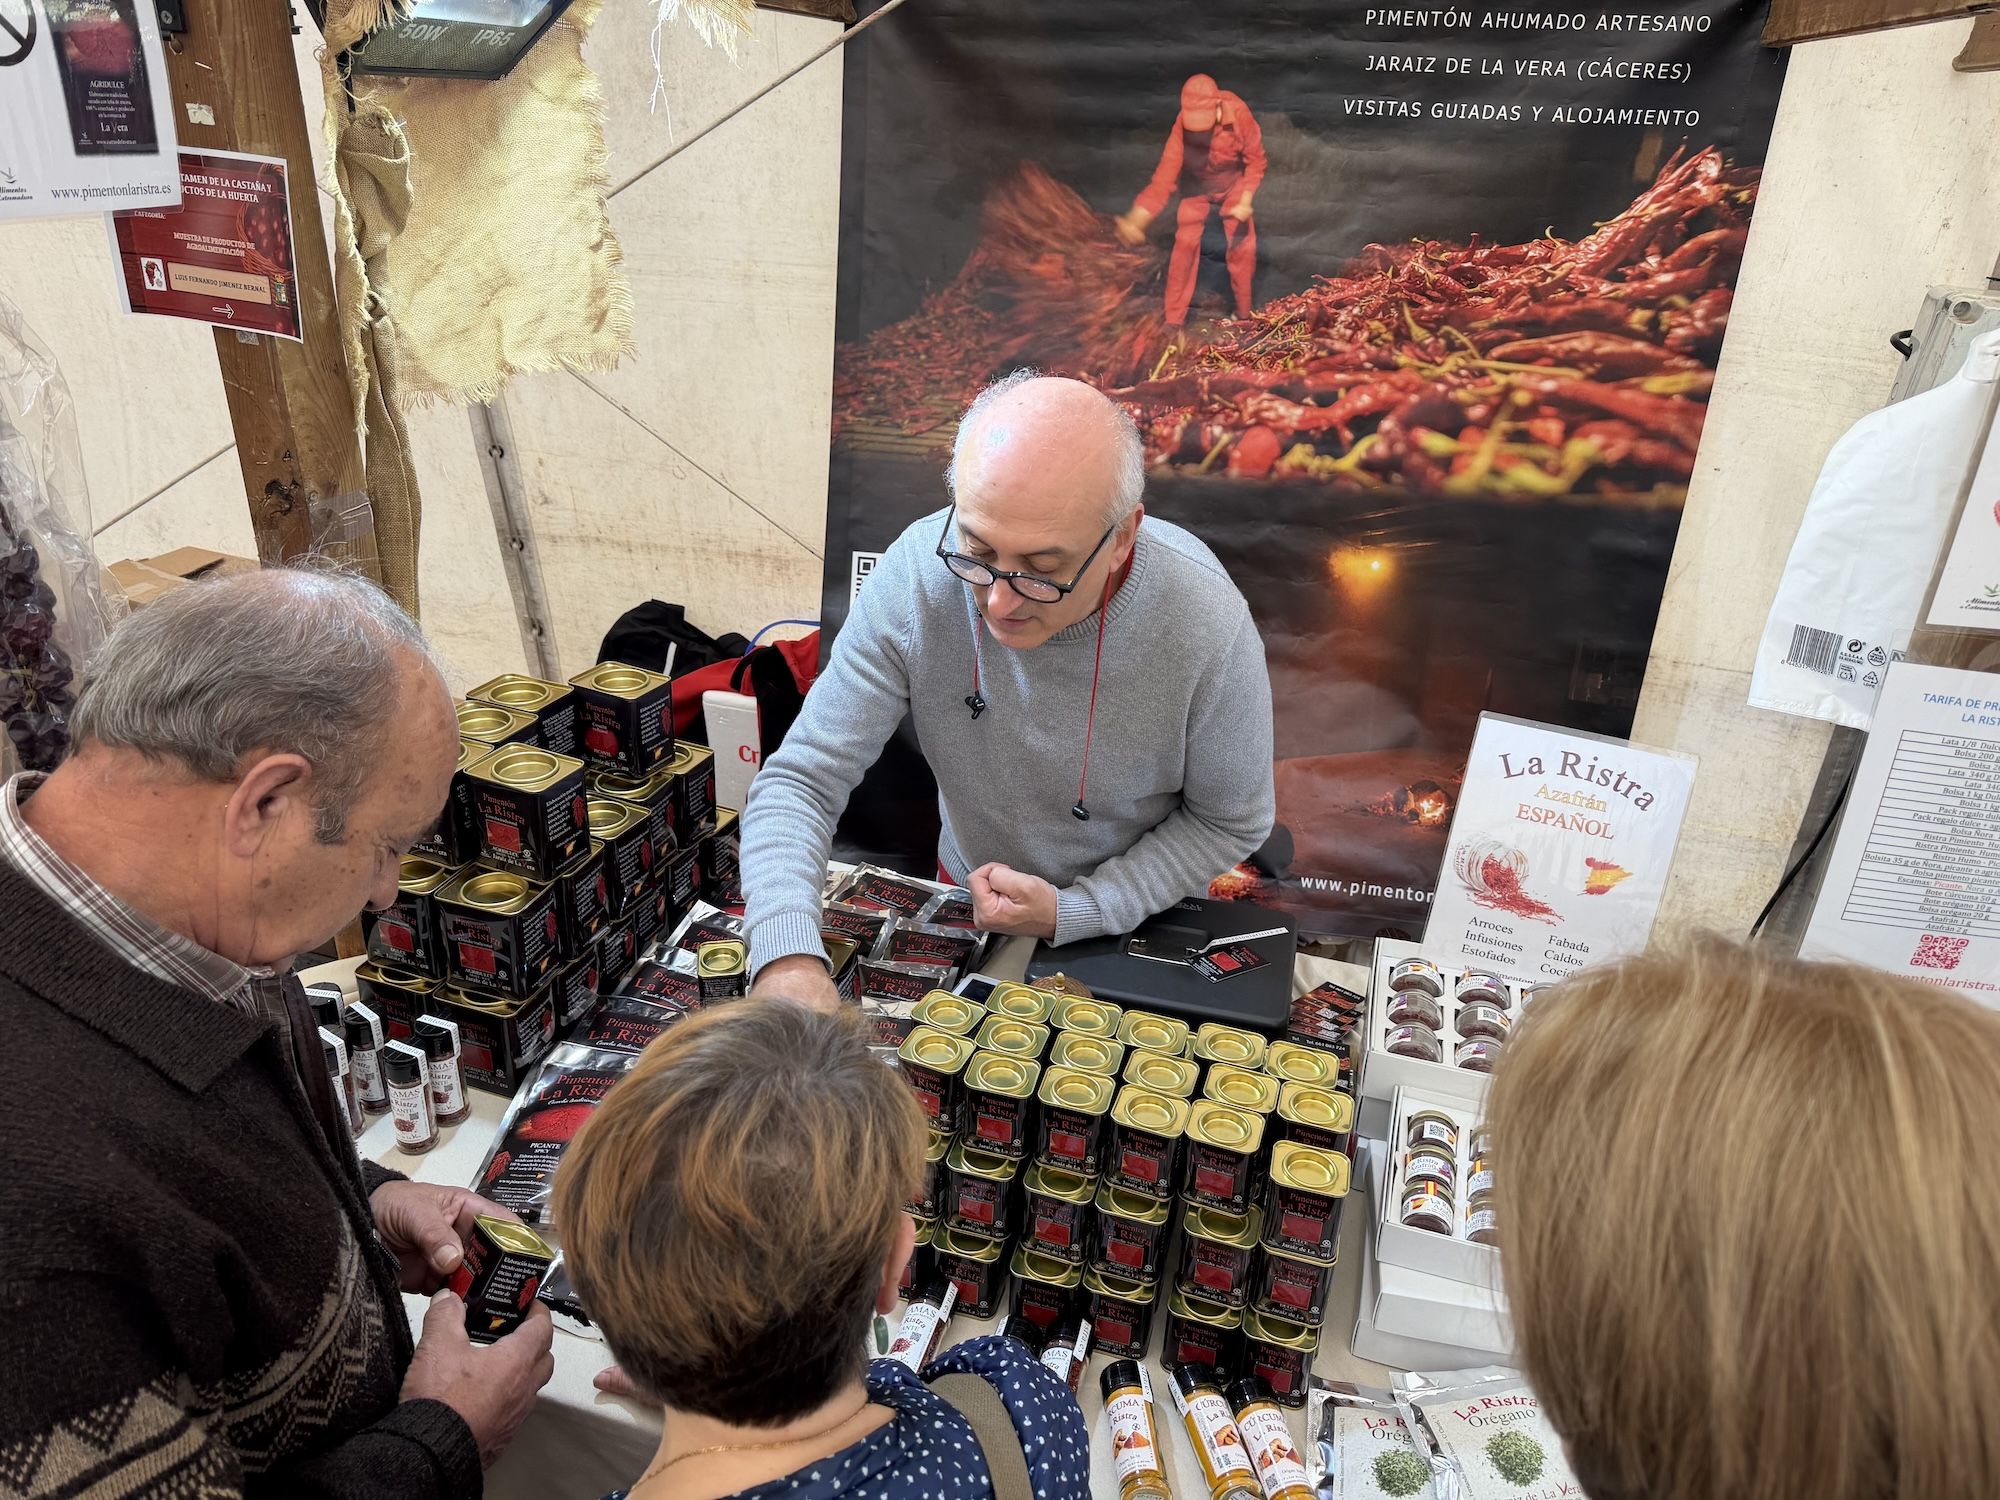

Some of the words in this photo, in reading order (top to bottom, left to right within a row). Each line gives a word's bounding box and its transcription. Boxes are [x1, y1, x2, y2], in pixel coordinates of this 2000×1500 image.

[1365, 6, 1472, 28] PIMENTÓN
[1481, 12, 1586, 30] AHUMADO
[1595, 15, 1711, 32] ARTESANO
[399, 23, 448, 41] 50W
[470, 29, 515, 46] IP65
[1365, 56, 1436, 73] JARAIZ
[1445, 57, 1472, 74] DE
[1481, 59, 1503, 75] LA
[1515, 60, 1566, 77] VERA
[1577, 57, 1692, 83] (CÁCERES)
[1343, 100, 1422, 117] VISITAS
[1432, 102, 1521, 120] GUIADAS
[1532, 106, 1543, 121] Y
[1552, 107, 1700, 127] ALOJAMIENTO
[51, 183, 172, 201] www.pimentonlaristra.es
[209, 176, 219, 186] DE
[220, 178, 231, 188] LA
[231, 178, 266, 192] CASTAÑA
[267, 183, 272, 192] Y
[206, 187, 216, 197] DE
[217, 190, 226, 199] LA
[229, 190, 259, 203] HUERTA
[1923, 693, 1962, 706] TARIFA
[1965, 699, 1981, 709] DE
[1961, 713, 1975, 722] LA
[1941, 737, 1959, 745] Lata
[1961, 739, 1977, 748] 1/8
[1954, 749, 1976, 758] Bolsa
[1978, 751, 1994, 760] 200
[1948, 768, 1965, 776] Lata
[1969, 770, 1985, 779] 340
[1968, 761, 1990, 770] Bolsa
[1499, 752, 1545, 779] La
[1556, 751, 1655, 811] Ristra
[1965, 780, 1982, 788] Lata
[1534, 782, 1607, 812] Azafrán
[1943, 787, 1964, 796] Bolsa
[1939, 806, 1958, 815] Pack
[1960, 799, 1981, 808] Bolsa
[1515, 803, 1615, 840] ESPAÑOL
[1913, 813, 1931, 821] Pack
[1924, 833, 1947, 842] Ristra
[1949, 836, 1985, 846] Pimiento
[1951, 827, 1972, 836] Bolsa
[1915, 841, 1939, 850] Ristra
[1940, 844, 1976, 854] Pimiento
[1865, 853, 1891, 863] Bolsita
[1911, 858, 1920, 866] de
[1944, 863, 1973, 873] picante
[1932, 853, 1956, 862] Ristra
[1958, 855, 1981, 864] Humo
[1913, 869, 1933, 877] Bolsa
[1935, 872, 1970, 882] pimiento
[880, 888, 918, 910] Ristra
[1923, 896, 1941, 905] Bote
[1925, 888, 1942, 897] Bote
[1918, 904, 1939, 914] Bolsa
[1468, 915, 1514, 935] Arroces
[1925, 923, 1955, 932] Azafrán
[1928, 915, 1958, 924] Azafrán
[832, 920, 874, 938] Ristra
[896, 940, 915, 950] La
[921, 943, 965, 957] Ristra
[1464, 929, 1524, 953] Infusiones
[1548, 934, 1590, 953] Fabada
[1461, 944, 1517, 966] Estofados
[1544, 950, 1584, 967] Caldos
[870, 971, 924, 989] Pimentón
[635, 977, 656, 991] La
[661, 986, 702, 1010] Ristra
[606, 1018, 662, 1034] Pimentón
[589, 1030, 610, 1040] La
[557, 1074, 616, 1086] Pimentón
[540, 1087, 562, 1100] La
[971, 1103, 986, 1113] La
[989, 1104, 1020, 1121] Ristra
[1053, 1111, 1087, 1124] Pimentón
[1044, 1119, 1059, 1128] La
[1062, 1119, 1093, 1137] Ristra
[1135, 1142, 1168, 1160] Ristra
[1207, 1158, 1241, 1175] Ristra
[1290, 1193, 1328, 1207] Pimentón
[1298, 1202, 1332, 1220] Ristra
[1208, 1253, 1241, 1269] Ristra
[1287, 1270, 1321, 1288] Ristra
[1268, 1355, 1301, 1371] Ristra
[1454, 1404, 1480, 1421] La
[1481, 1395, 1539, 1410] Ristra
[1112, 1413, 1138, 1426] Ristra
[1206, 1412, 1220, 1423] La
[1363, 1417, 1389, 1430] La
[1469, 1408, 1536, 1429] Orégano
